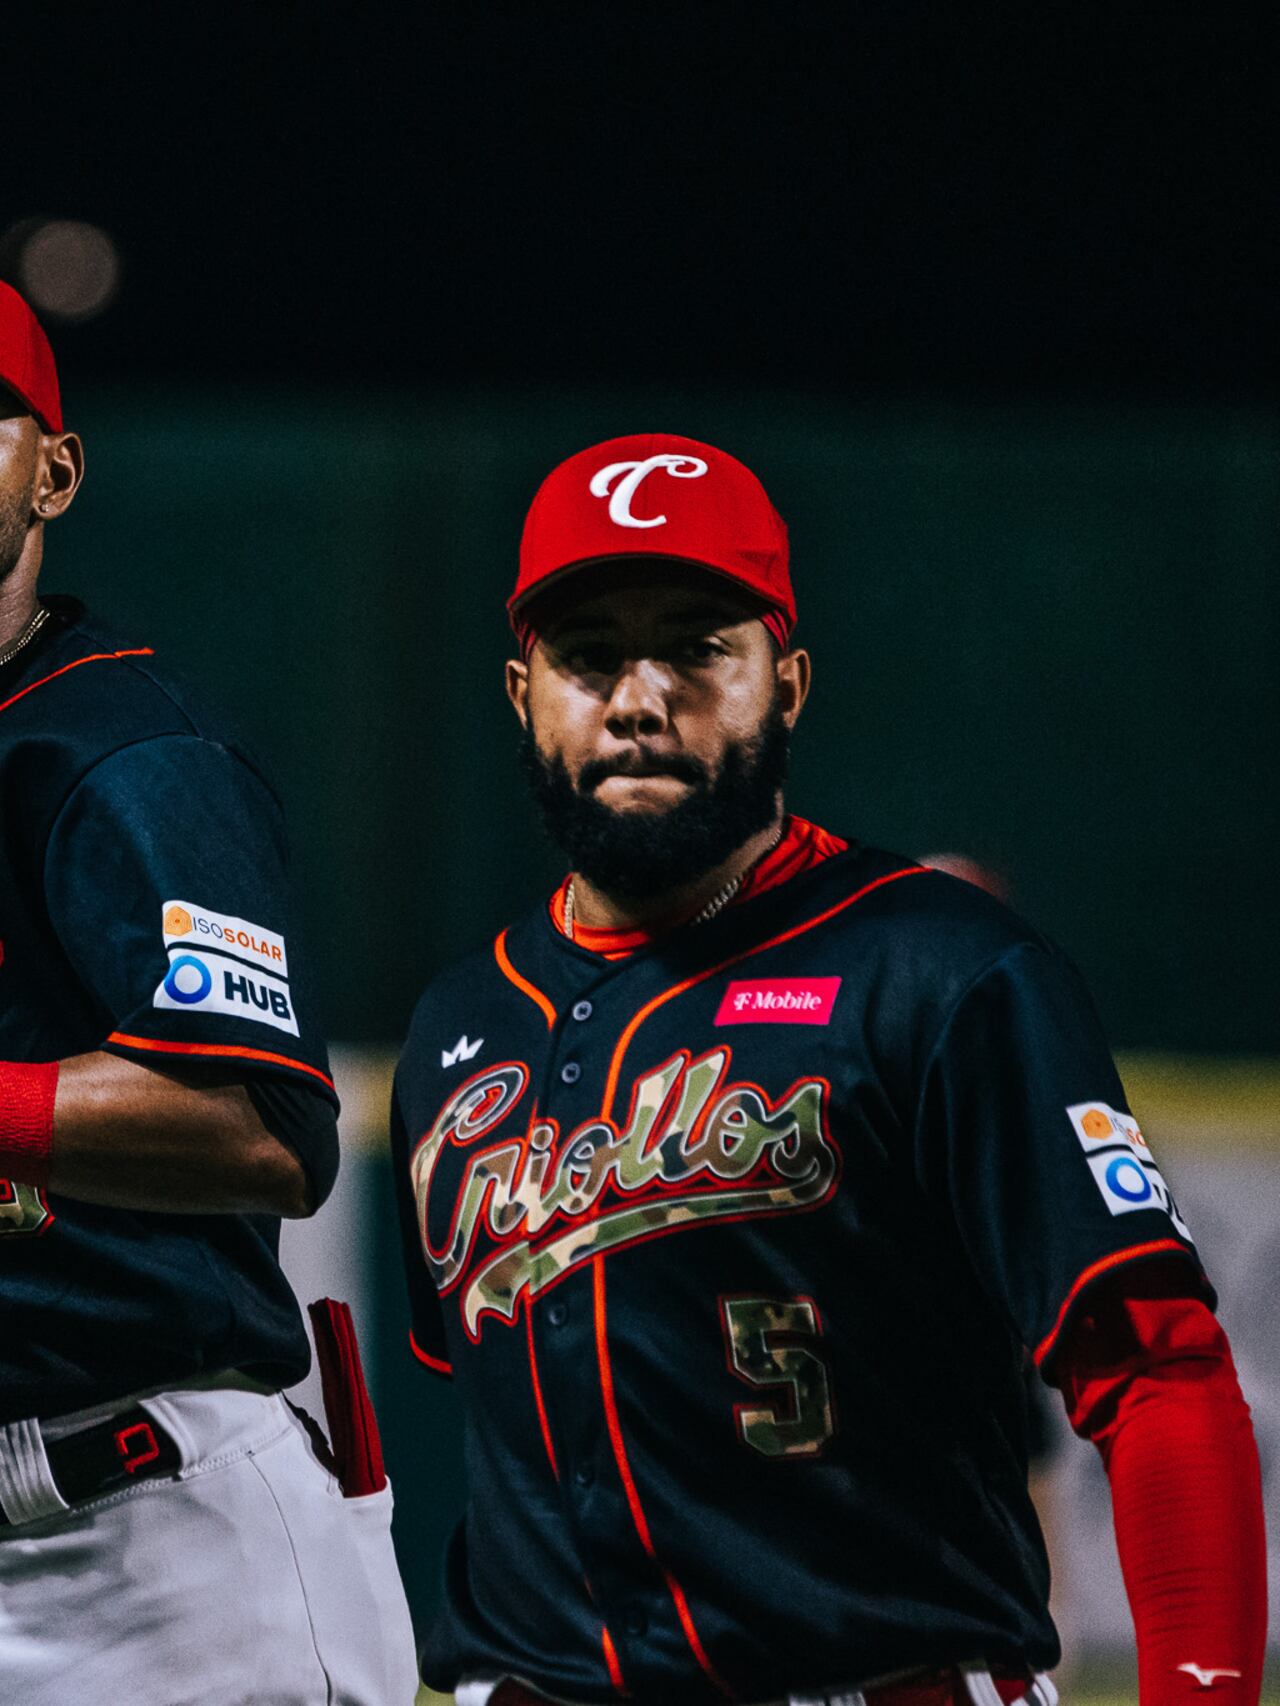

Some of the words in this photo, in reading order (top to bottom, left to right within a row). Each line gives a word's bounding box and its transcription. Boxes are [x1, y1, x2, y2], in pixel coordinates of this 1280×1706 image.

[589, 453, 708, 529] C
[193, 916, 282, 962] ISOSOLAR
[223, 970, 291, 1020] HUB
[751, 990, 822, 1011] Mobile
[410, 1044, 843, 1305] Criollos
[718, 1294, 834, 1461] 5
